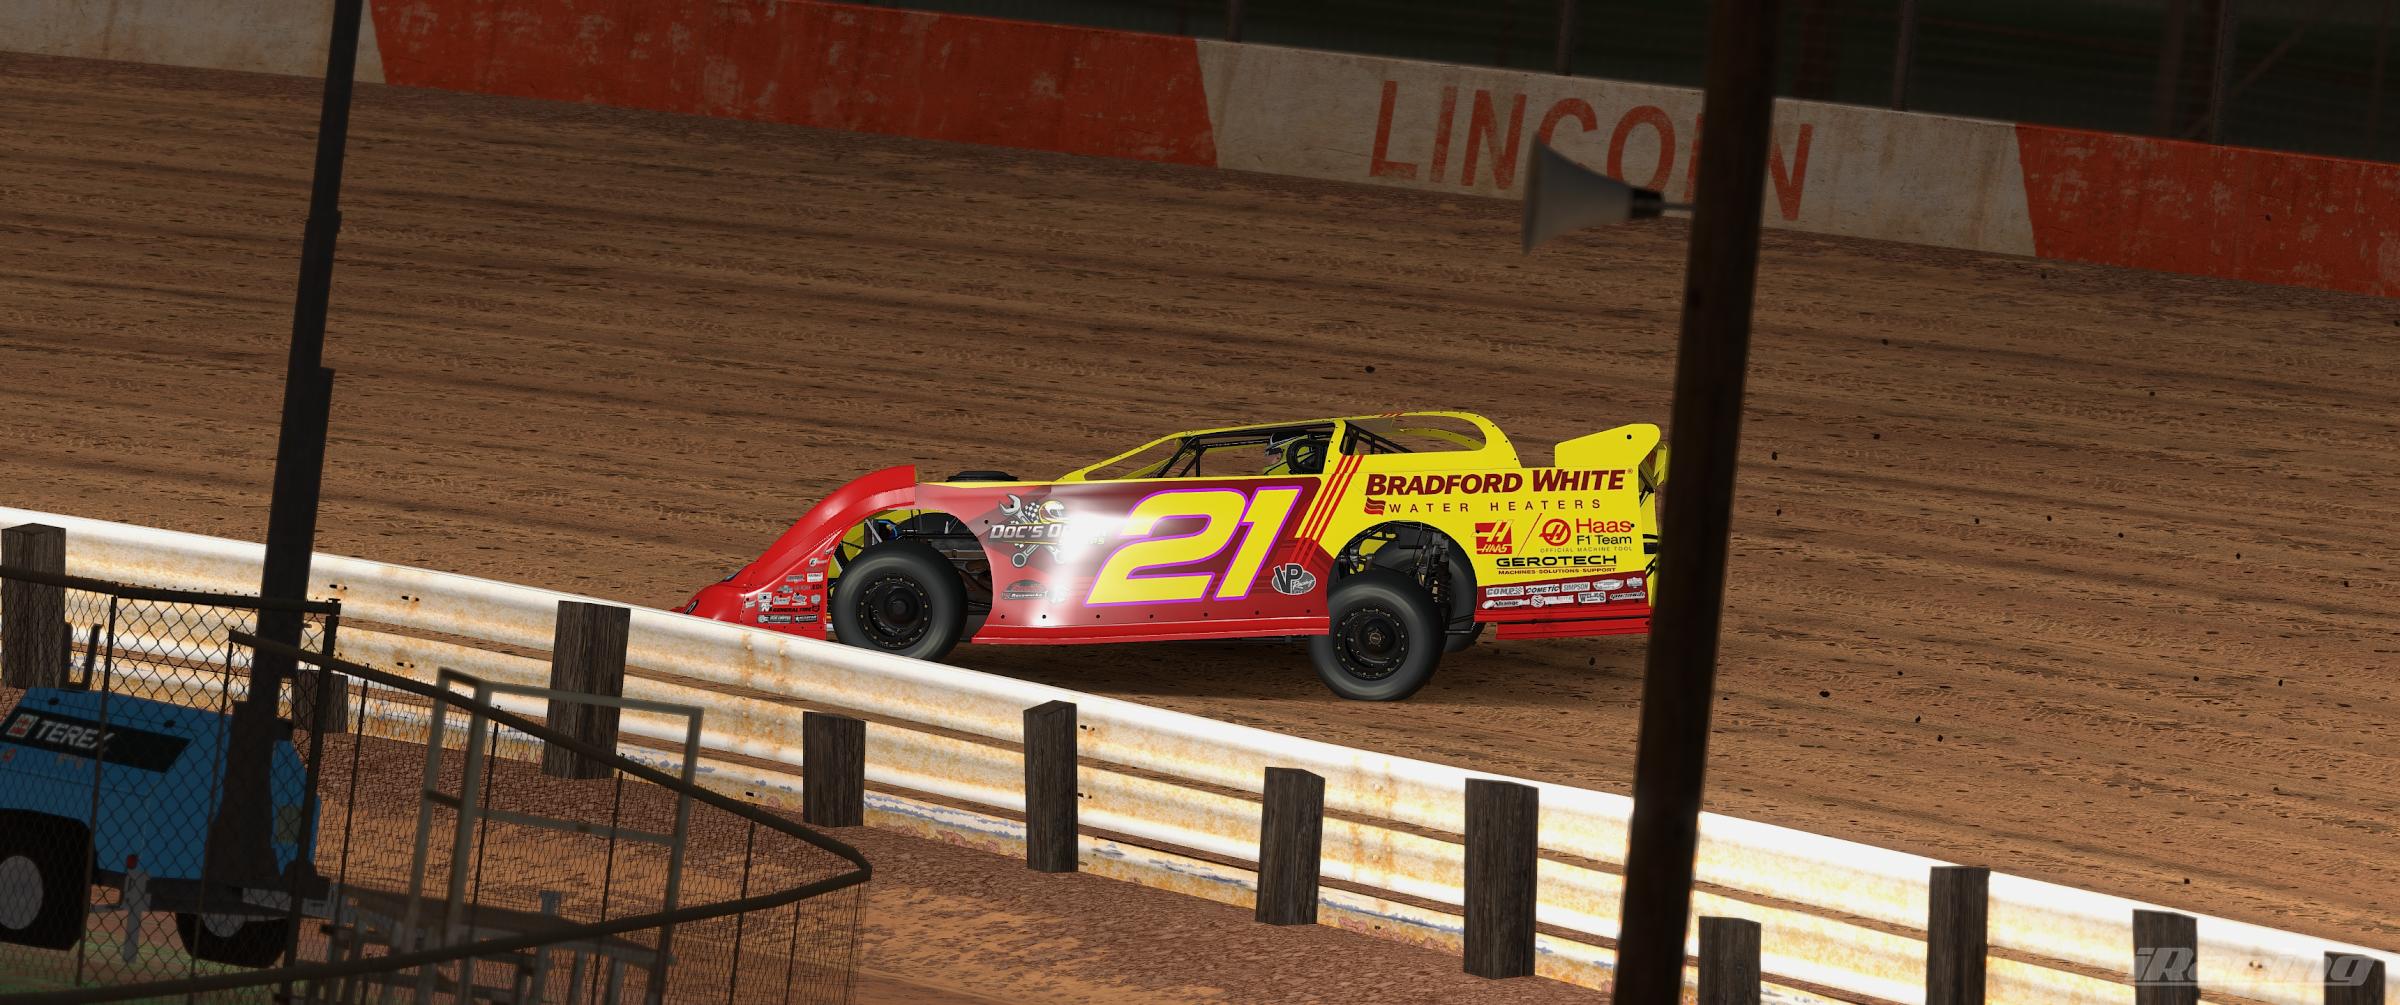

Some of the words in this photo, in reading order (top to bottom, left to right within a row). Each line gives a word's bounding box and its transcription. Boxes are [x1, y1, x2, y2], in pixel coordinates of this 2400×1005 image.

[1365, 472, 1523, 496] BRADFORD
[1532, 468, 1626, 492] WHITE
[1389, 502, 1469, 513] WATER
[1490, 498, 1601, 511] HEATERS
[1576, 518, 1632, 533] Haas
[1085, 486, 1304, 607] 21
[1577, 535, 1591, 545] F1
[1597, 534, 1632, 545] Team
[1480, 543, 1508, 553] HAAS
[1496, 555, 1617, 567] GEROTECH
[1273, 562, 1304, 594] VP
[1563, 583, 1589, 591] SIMPSON
